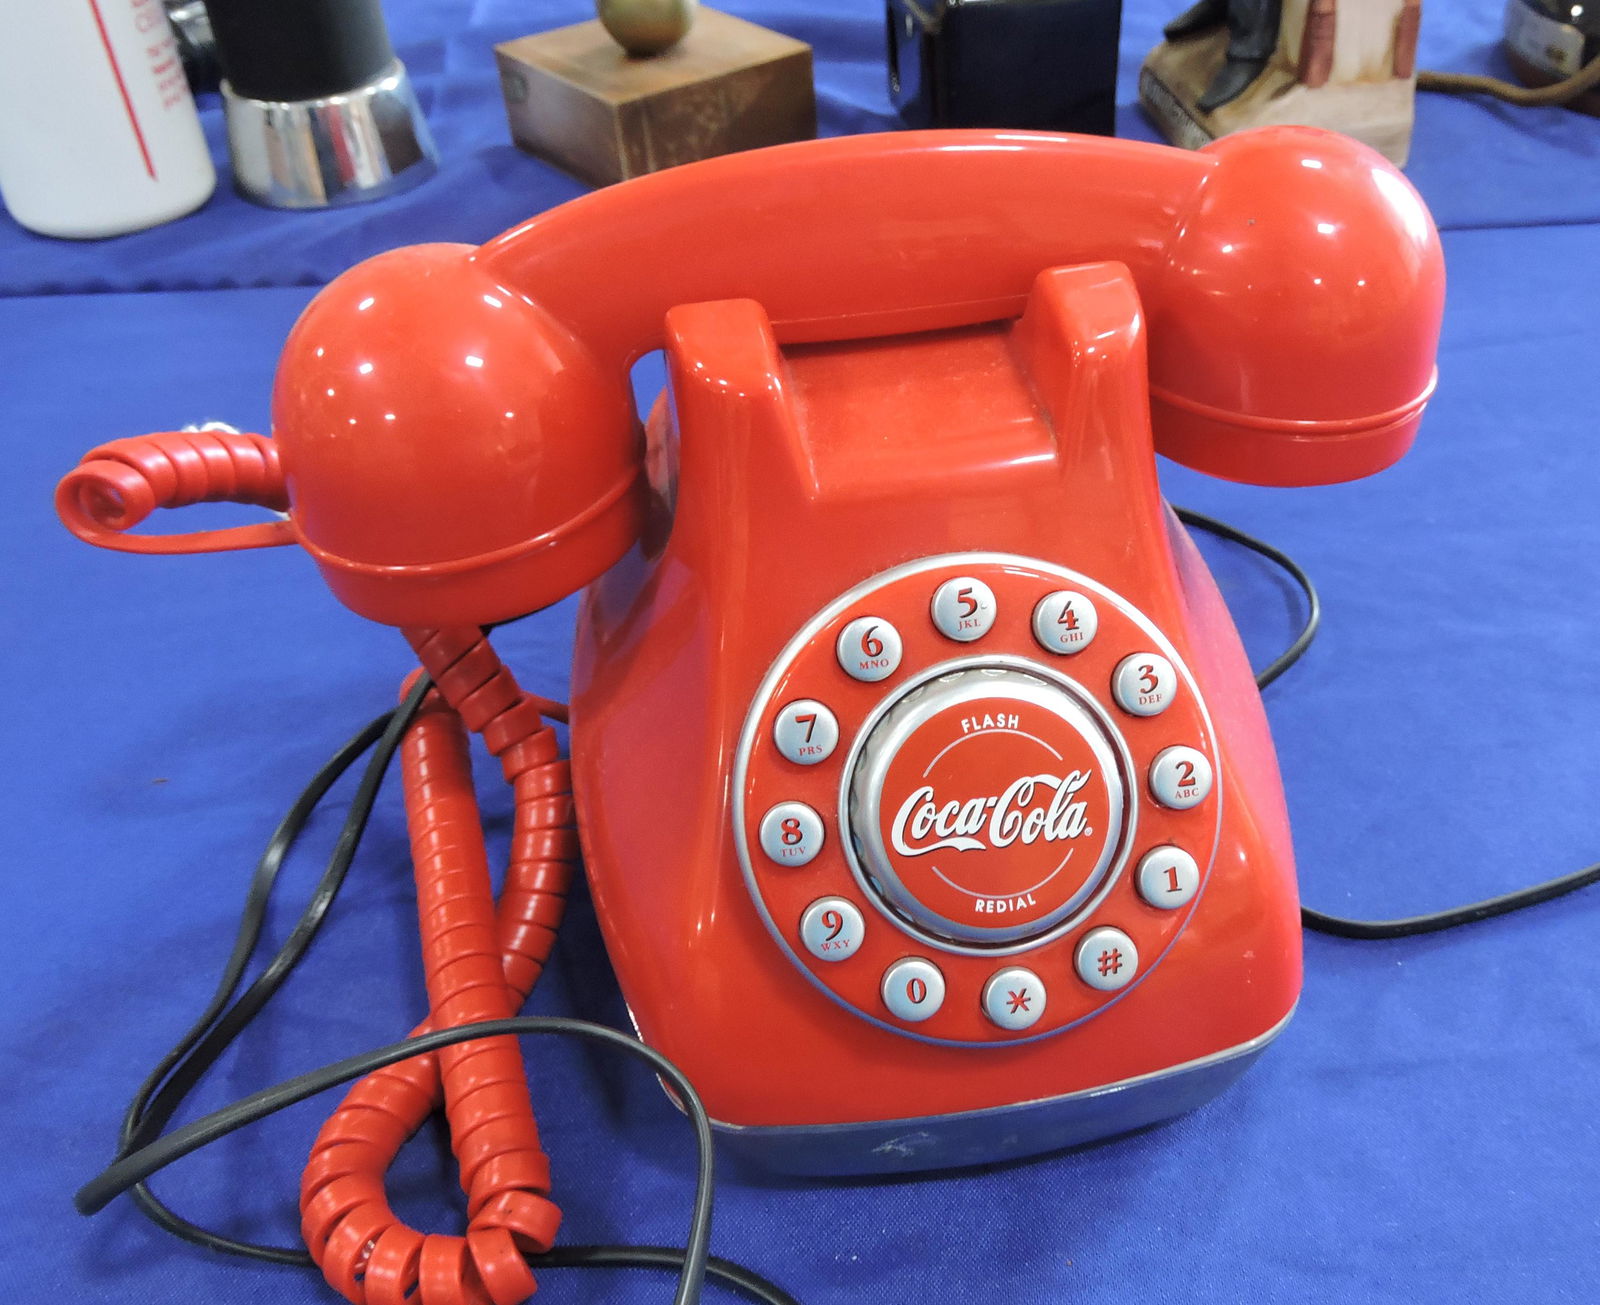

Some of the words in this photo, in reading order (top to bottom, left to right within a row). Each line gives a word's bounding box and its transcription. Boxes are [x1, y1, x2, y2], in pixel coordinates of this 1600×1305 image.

[957, 588, 978, 618] 5
[957, 619, 981, 631] JKL
[1058, 601, 1079, 630] 4
[861, 626, 883, 657] 6
[1060, 632, 1084, 643] GHI
[859, 658, 889, 669] MNO
[1139, 665, 1159, 693] 3
[1138, 693, 1162, 705] DEF
[795, 714, 816, 742] 7
[961, 713, 1019, 733] FLASH
[799, 745, 823, 755] PRS
[1176, 761, 1195, 787] 2
[1175, 788, 1199, 799] ABC
[780, 817, 802, 845] 8
[780, 847, 807, 857] TUV
[1162, 866, 1182, 892] 1
[975, 893, 1037, 913] REDIAL
[822, 910, 842, 941] 9
[821, 940, 850, 952] WXY
[906, 978, 927, 1004] 0
